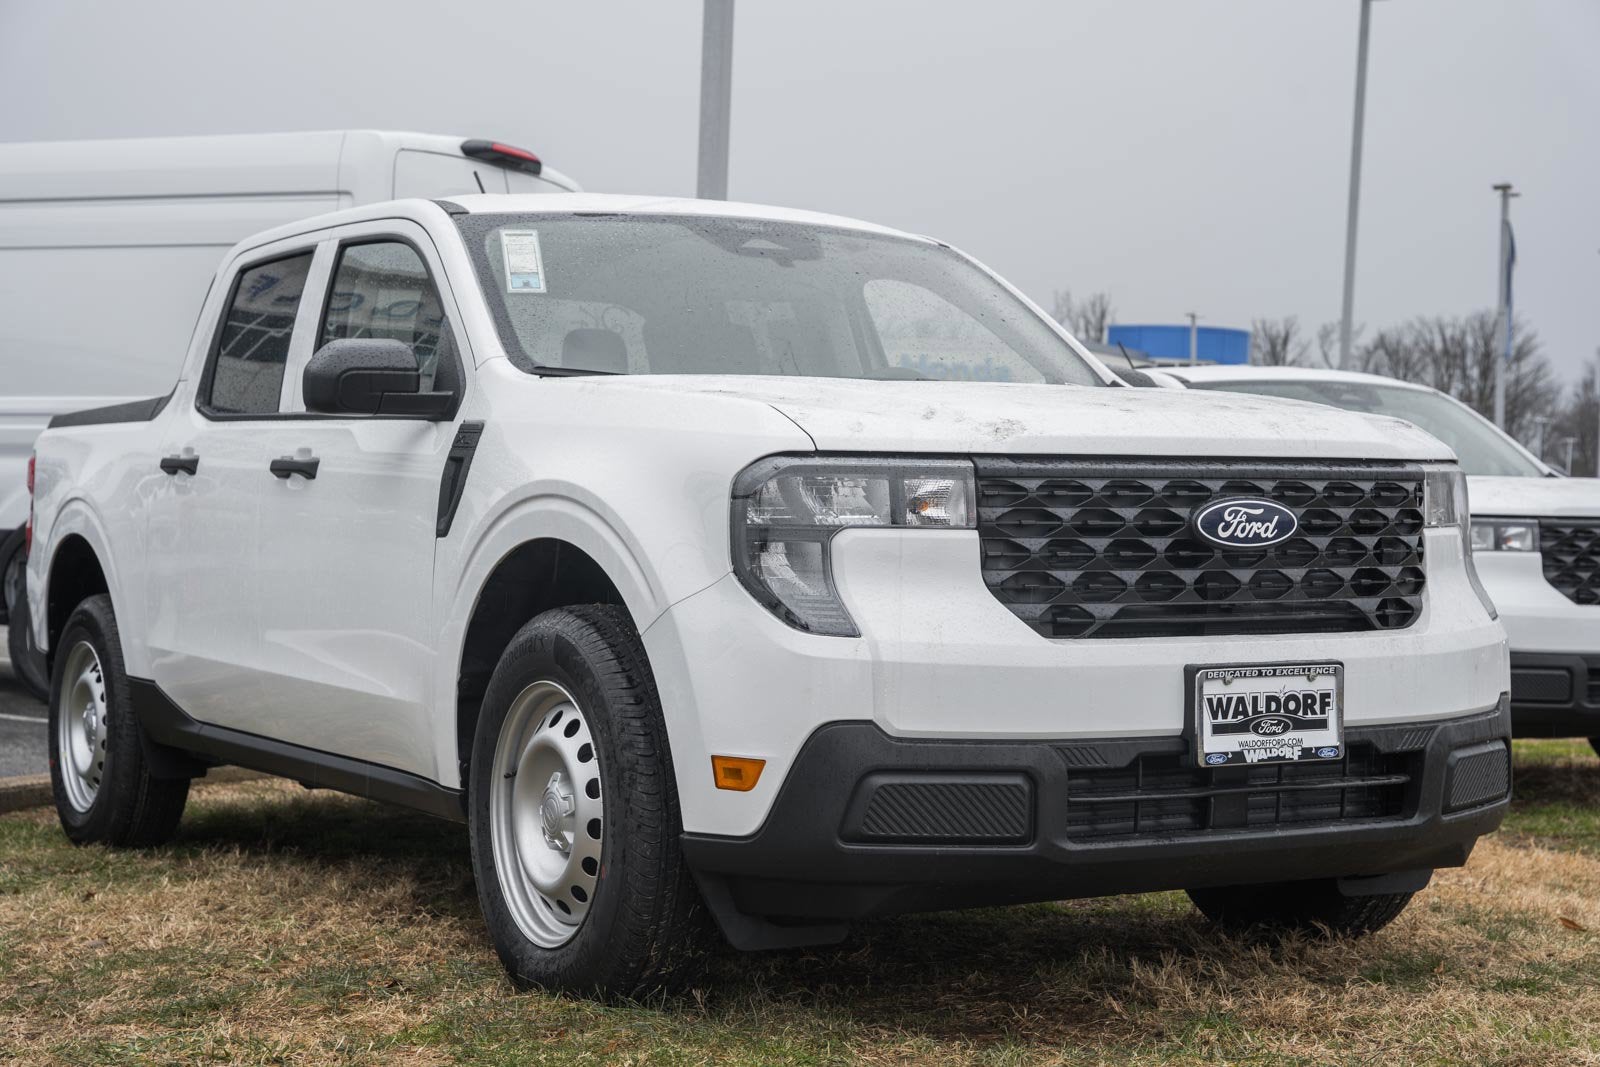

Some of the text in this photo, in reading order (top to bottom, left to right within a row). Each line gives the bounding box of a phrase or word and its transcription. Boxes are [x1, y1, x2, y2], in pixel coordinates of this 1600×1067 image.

[1217, 506, 1279, 538] Ford
[1207, 669, 1258, 679] DEDICATED
[1276, 667, 1336, 676] EXCELLENCE
[1205, 692, 1331, 720] WALDORF
[1258, 719, 1284, 734] Ford
[1238, 738, 1304, 748] WALDORFFORD.COM
[1243, 747, 1302, 764] WALDORF
